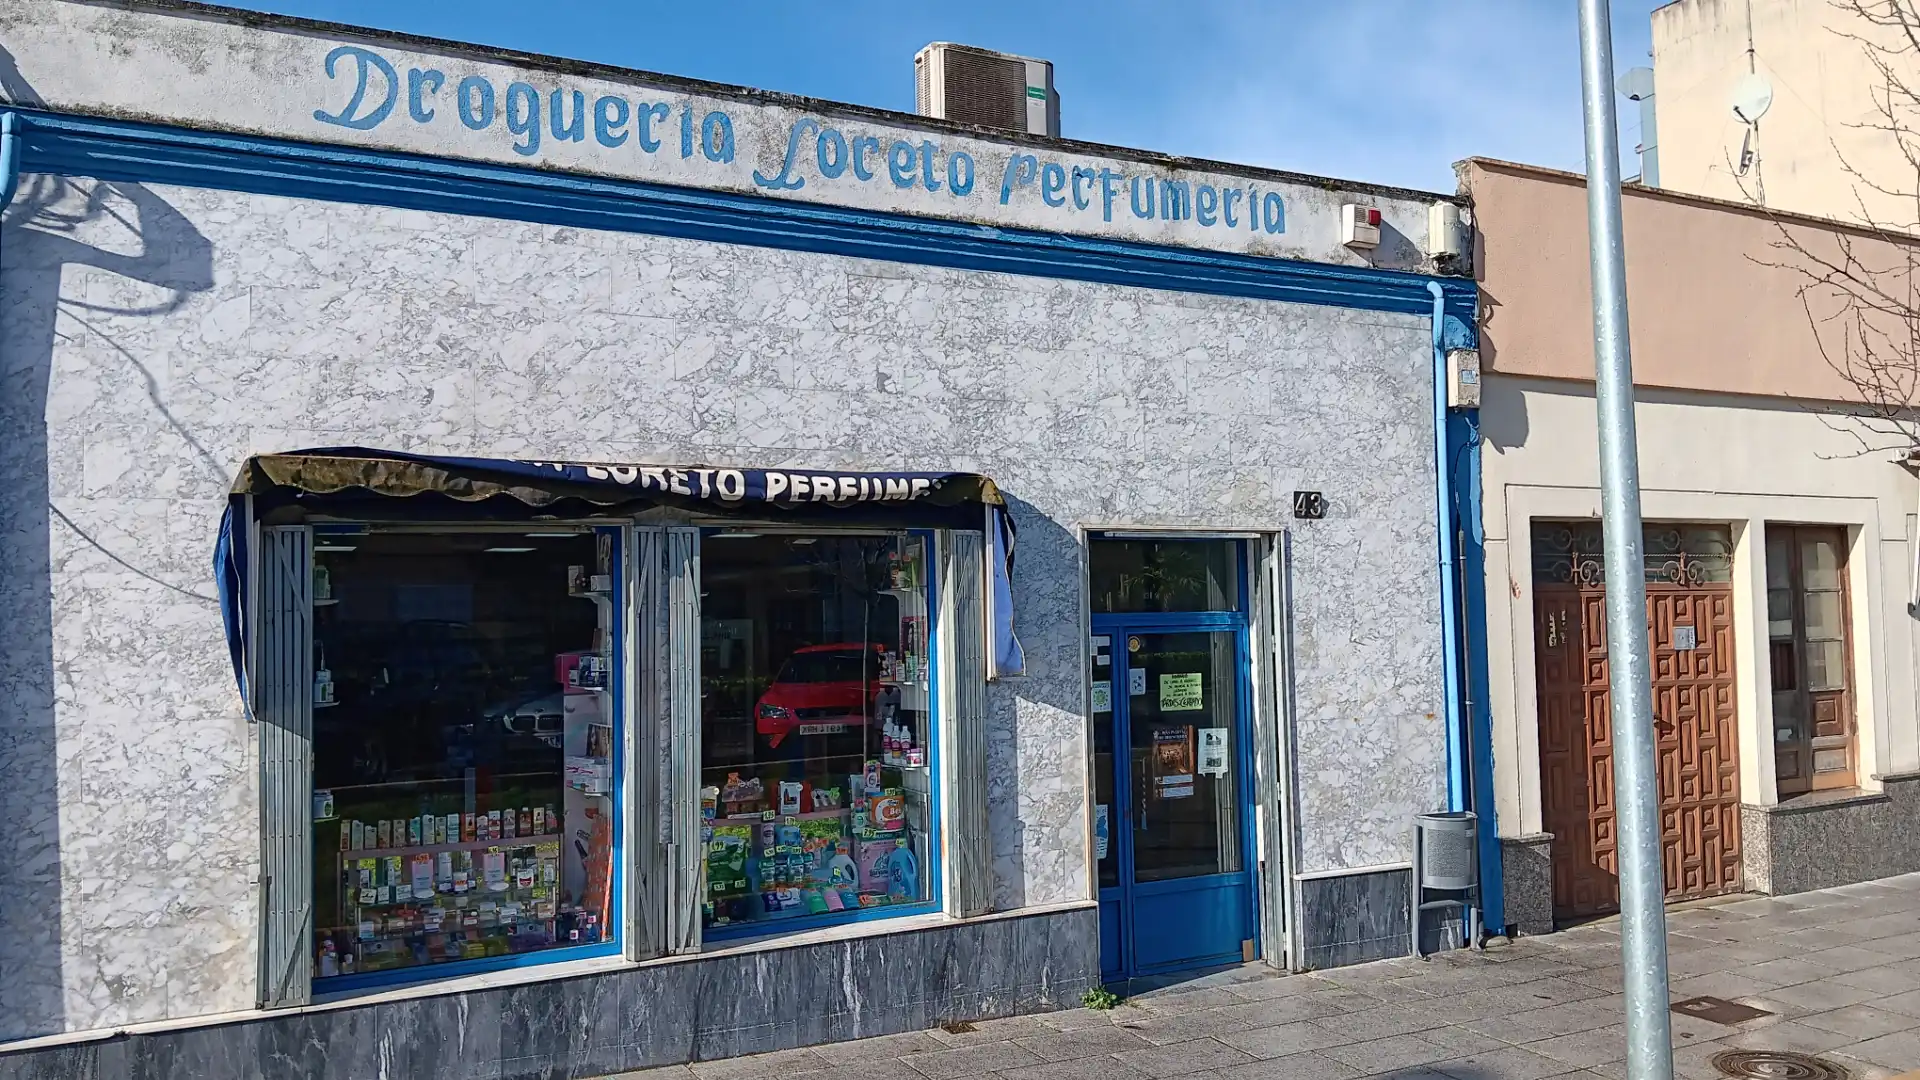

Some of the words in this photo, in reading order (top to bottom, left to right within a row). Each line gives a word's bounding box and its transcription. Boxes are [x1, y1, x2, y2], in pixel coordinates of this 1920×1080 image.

[753, 117, 975, 197] Loreto
[765, 471, 949, 502] PERFUME
[1295, 493, 1321, 516] 43
